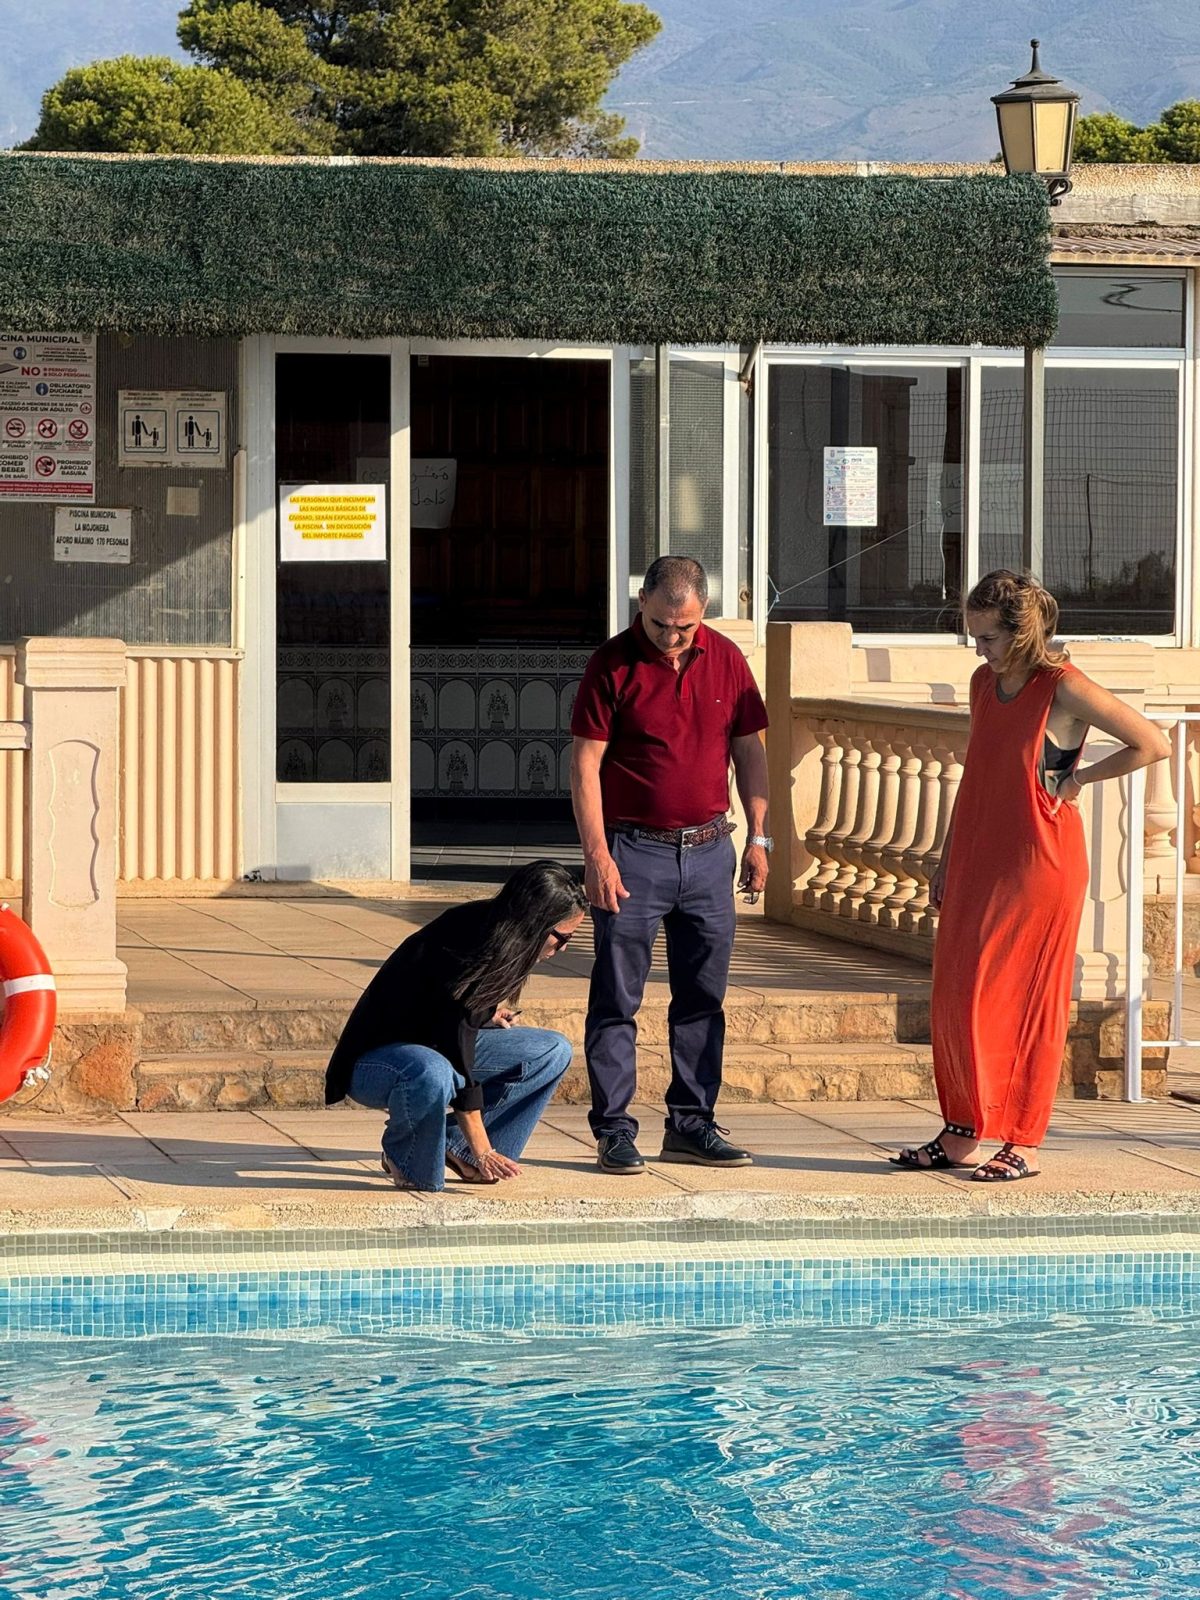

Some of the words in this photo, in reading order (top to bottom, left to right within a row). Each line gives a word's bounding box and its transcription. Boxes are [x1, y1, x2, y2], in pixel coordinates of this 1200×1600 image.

[0, 334, 24, 342] CINA
[27, 335, 80, 344] MUNICIPAL
[21, 366, 41, 376] NO
[69, 509, 89, 518] PISCINA
[90, 510, 117, 519] MUNICIPAL
[74, 523, 81, 531] LA
[82, 523, 110, 532] MOJONERA
[56, 536, 73, 544] AFORO
[96, 537, 106, 545] 170
